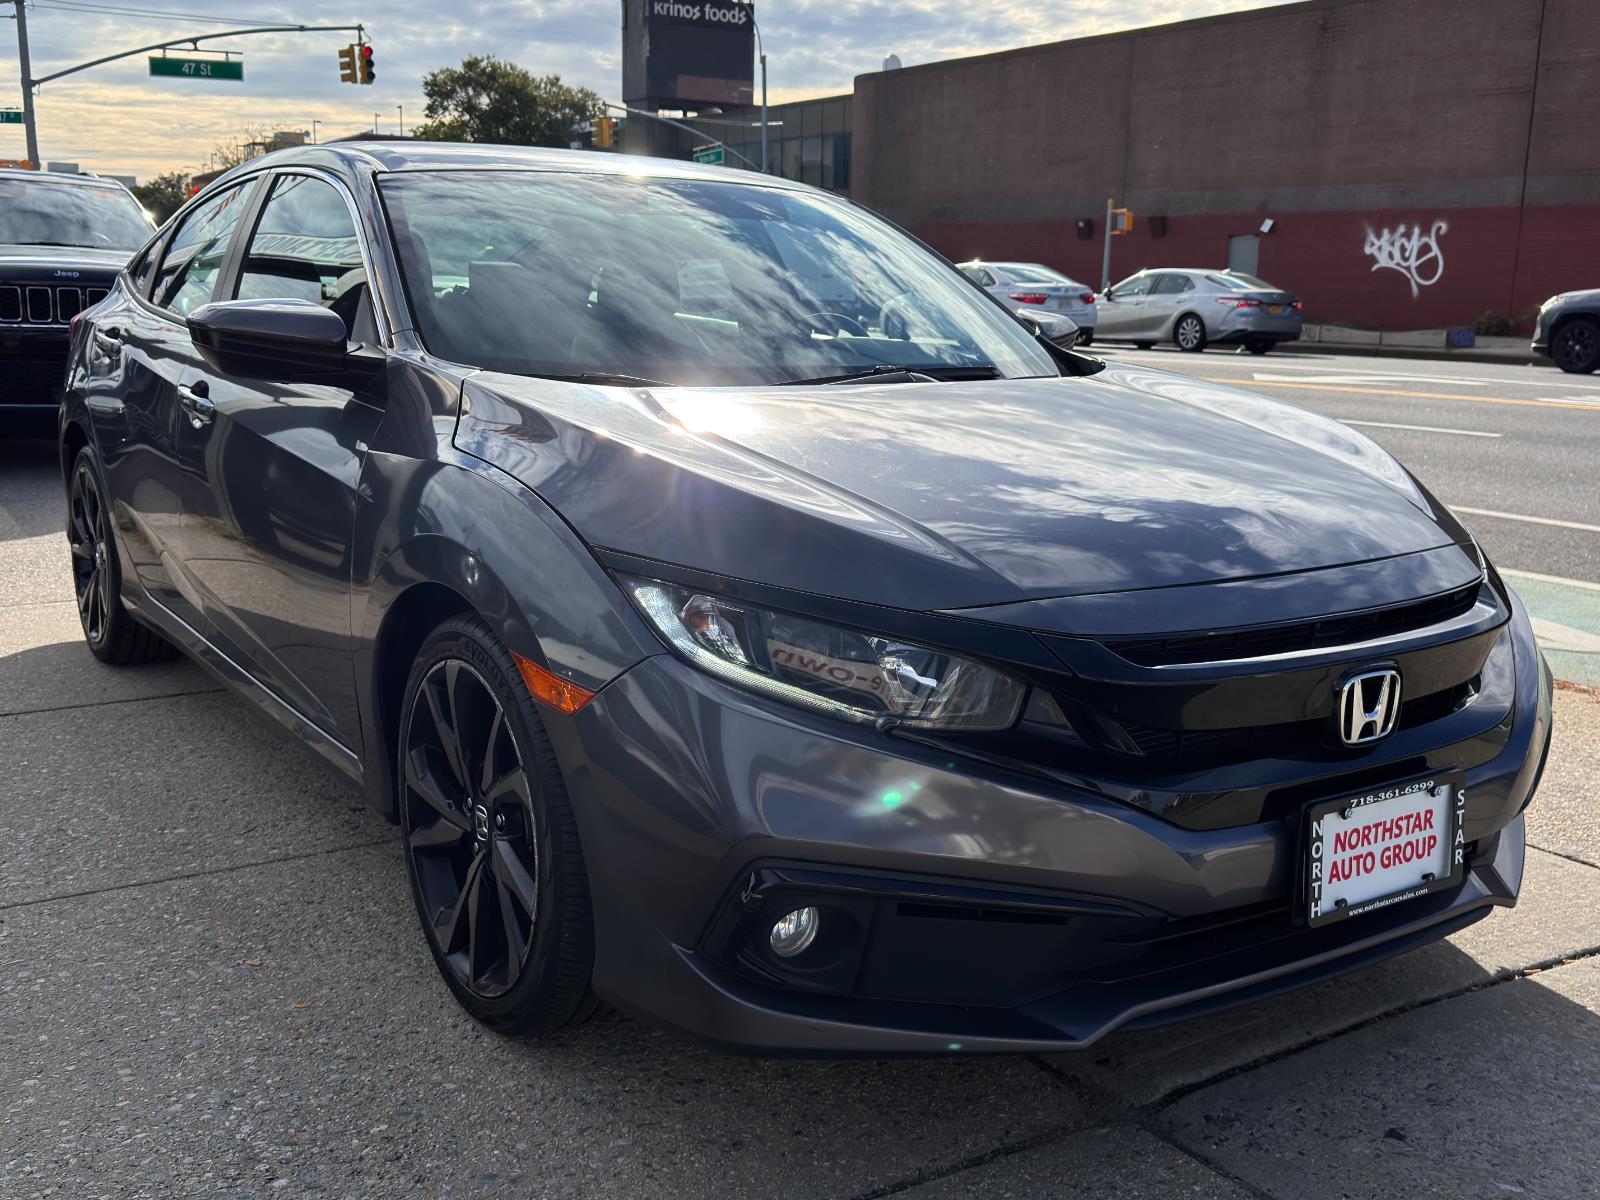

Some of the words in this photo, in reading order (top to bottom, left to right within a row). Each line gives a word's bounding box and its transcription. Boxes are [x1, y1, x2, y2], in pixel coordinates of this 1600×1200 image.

[704, 3, 747, 24] foods
[181, 62, 196, 75] 47
[200, 63, 213, 76] St
[53, 270, 80, 279] Jeep
[1350, 780, 1434, 808] 718-361-6299
[1333, 808, 1434, 855] NORTHSTAR
[1454, 789, 1466, 865] STAR
[1311, 819, 1324, 918] NORTH
[1328, 851, 1376, 884] AUTO
[1379, 834, 1437, 870] GROUP
